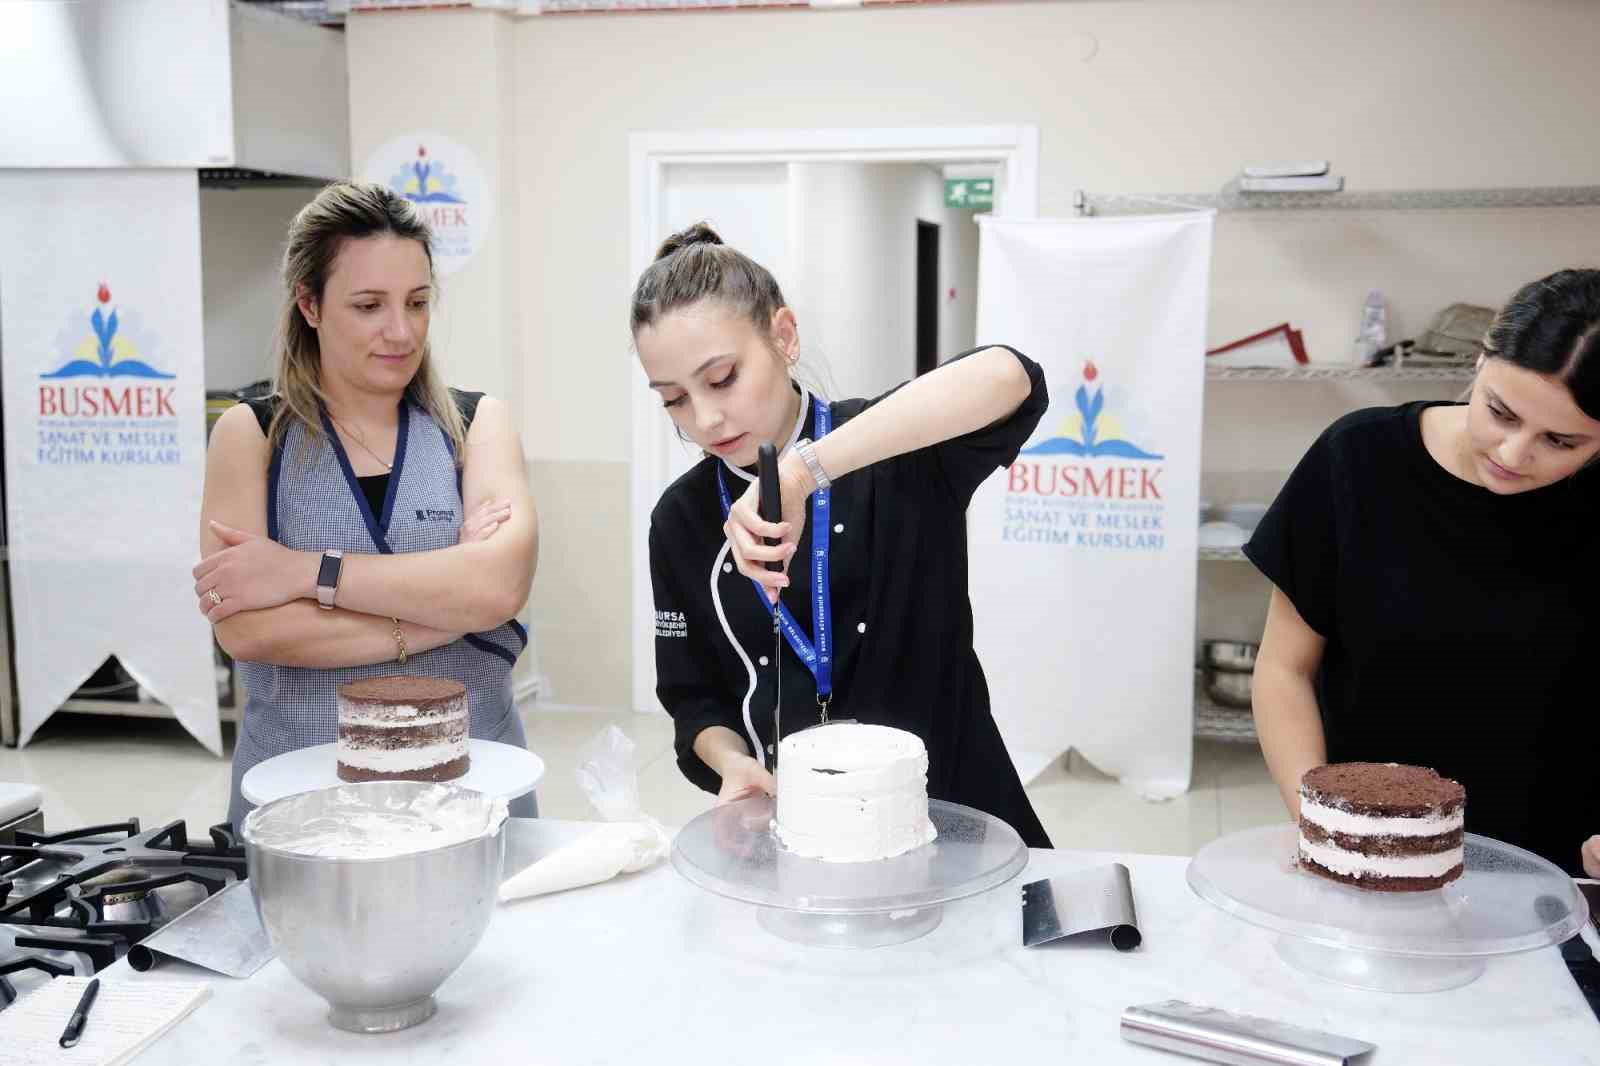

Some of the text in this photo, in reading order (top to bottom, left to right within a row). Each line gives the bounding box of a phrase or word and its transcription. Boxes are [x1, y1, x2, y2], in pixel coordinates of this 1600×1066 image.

[39, 386, 176, 416] BUSMEK
[38, 431, 177, 446] SANAT VE MESLEK
[101, 450, 181, 464] KURSLARI
[1007, 463, 1164, 499] BUSMEK
[1006, 509, 1162, 529] SANAT VE MESLEK
[1076, 533, 1165, 549] KURSLARI
